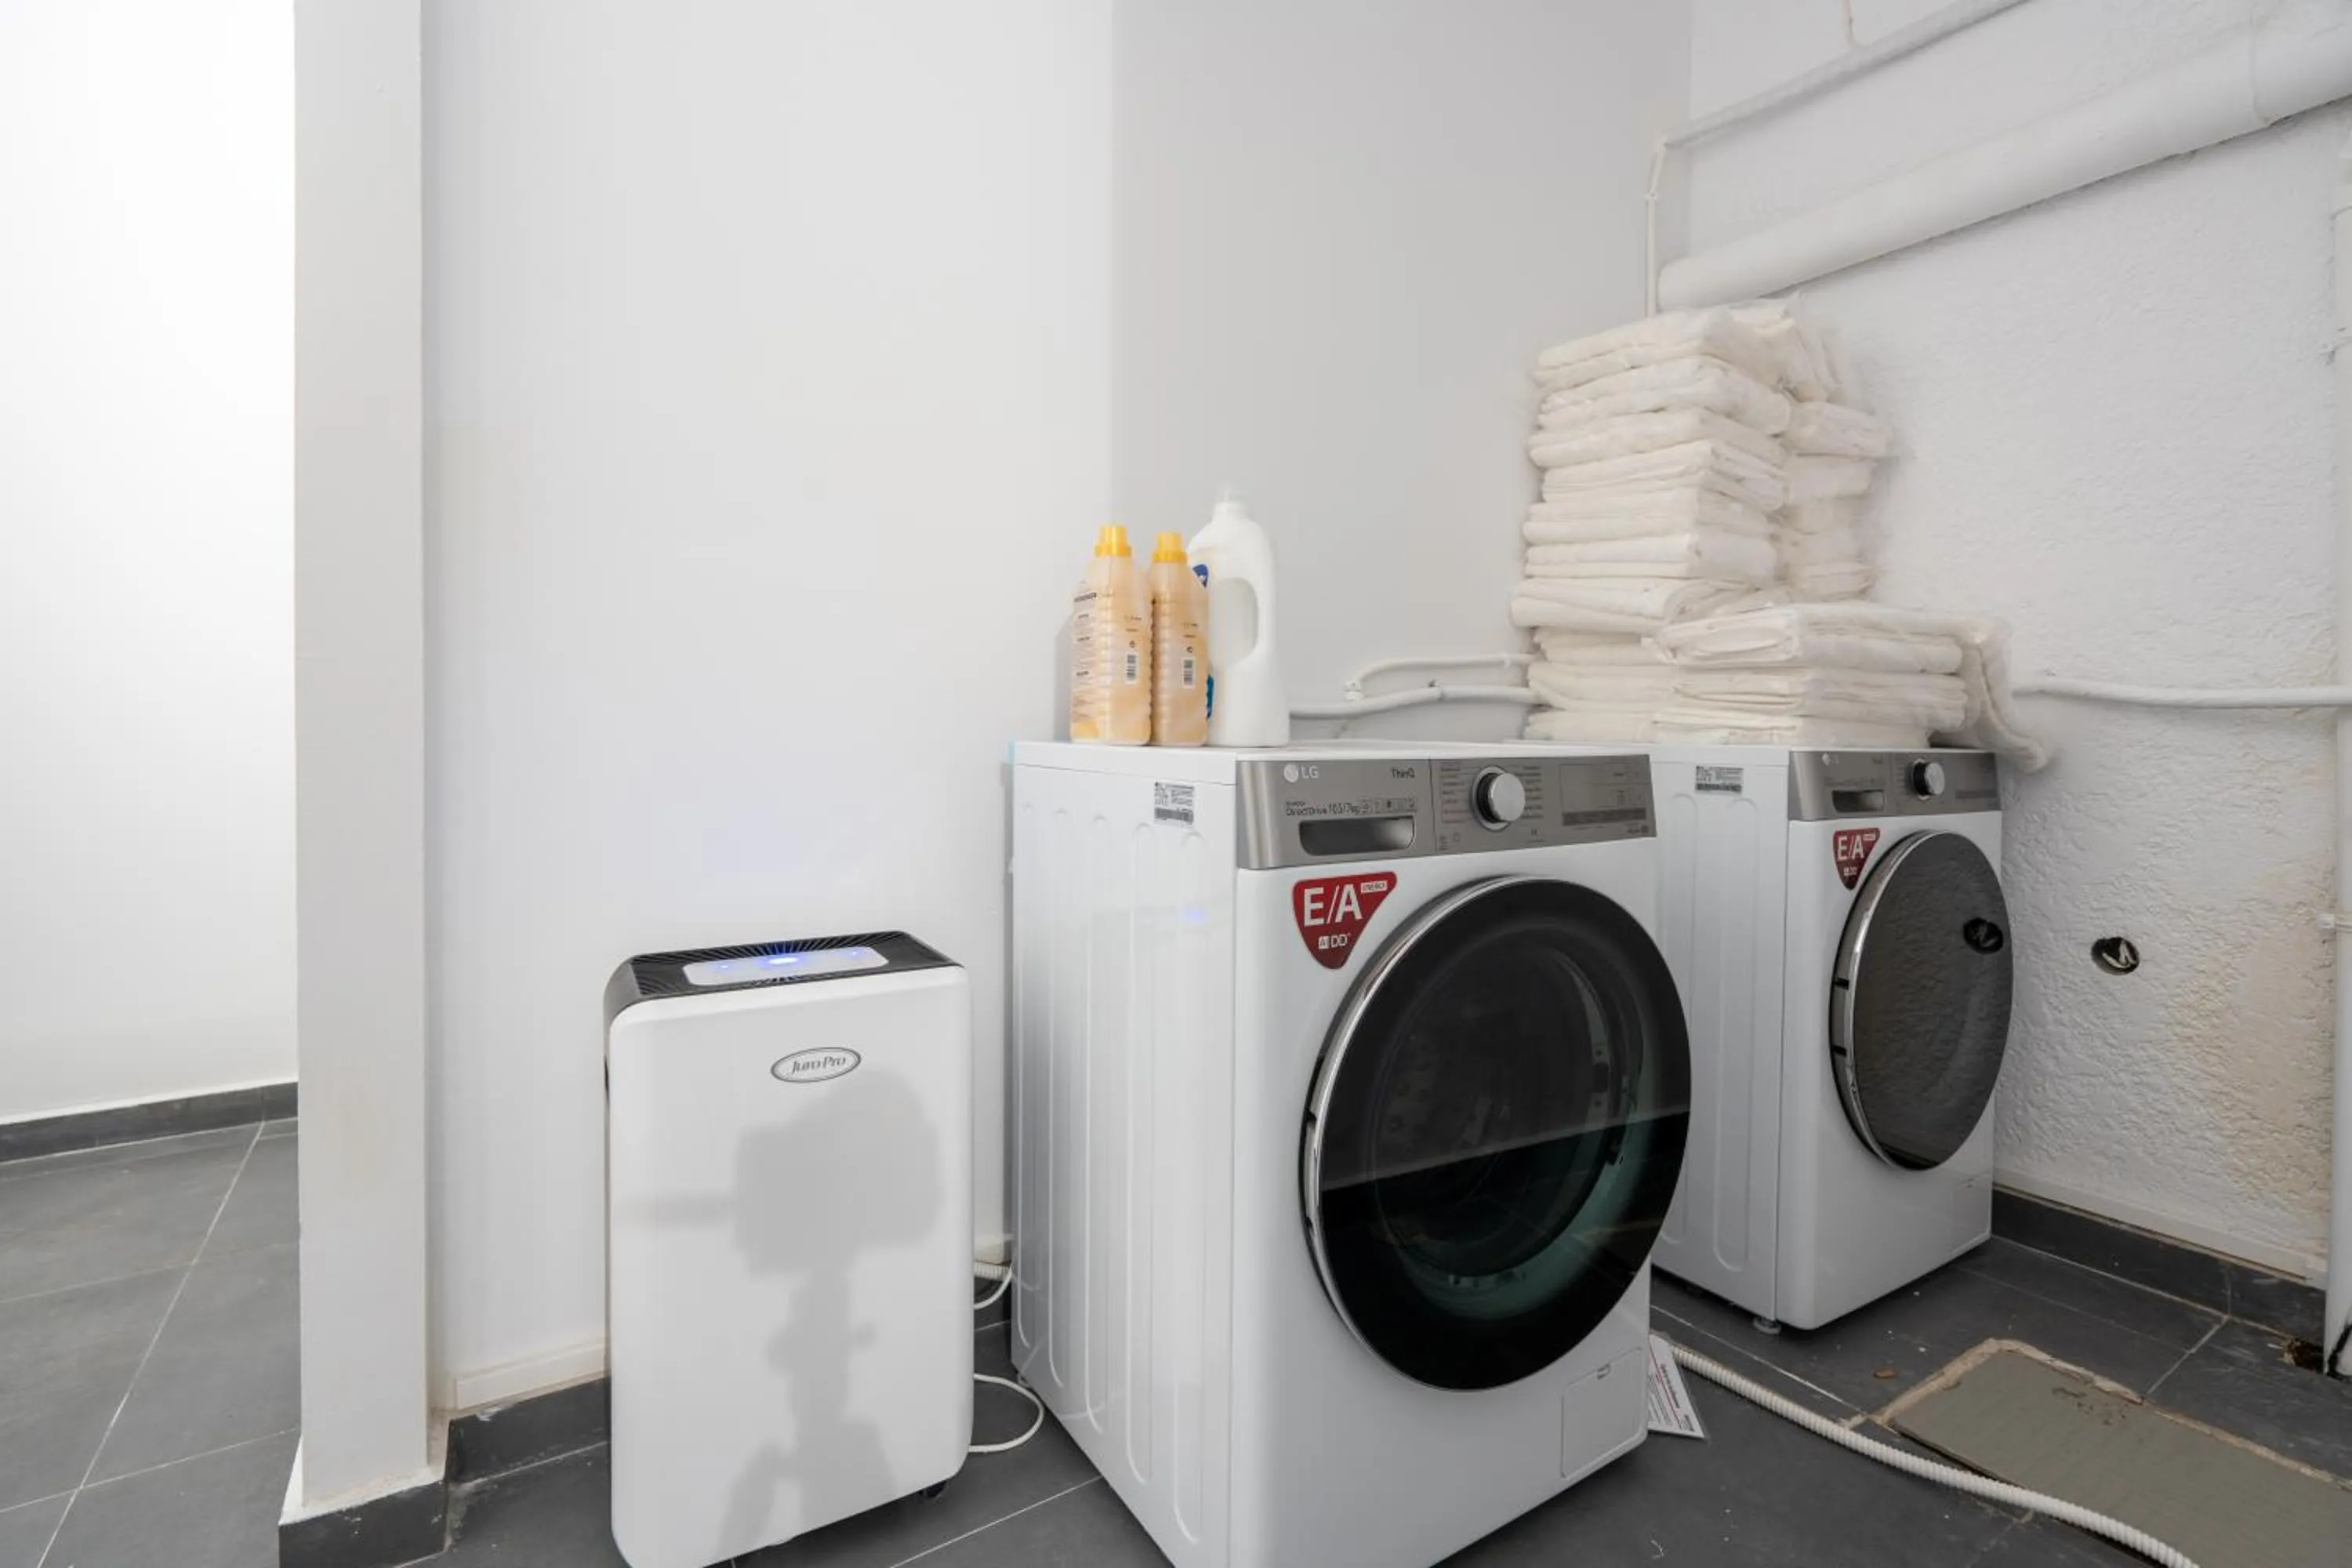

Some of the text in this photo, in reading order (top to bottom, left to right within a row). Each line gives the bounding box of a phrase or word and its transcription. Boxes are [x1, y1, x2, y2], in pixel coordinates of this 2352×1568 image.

[1301, 765, 1319, 779] LG
[1837, 835, 1864, 862] E/A
[1304, 884, 1363, 927] E/A
